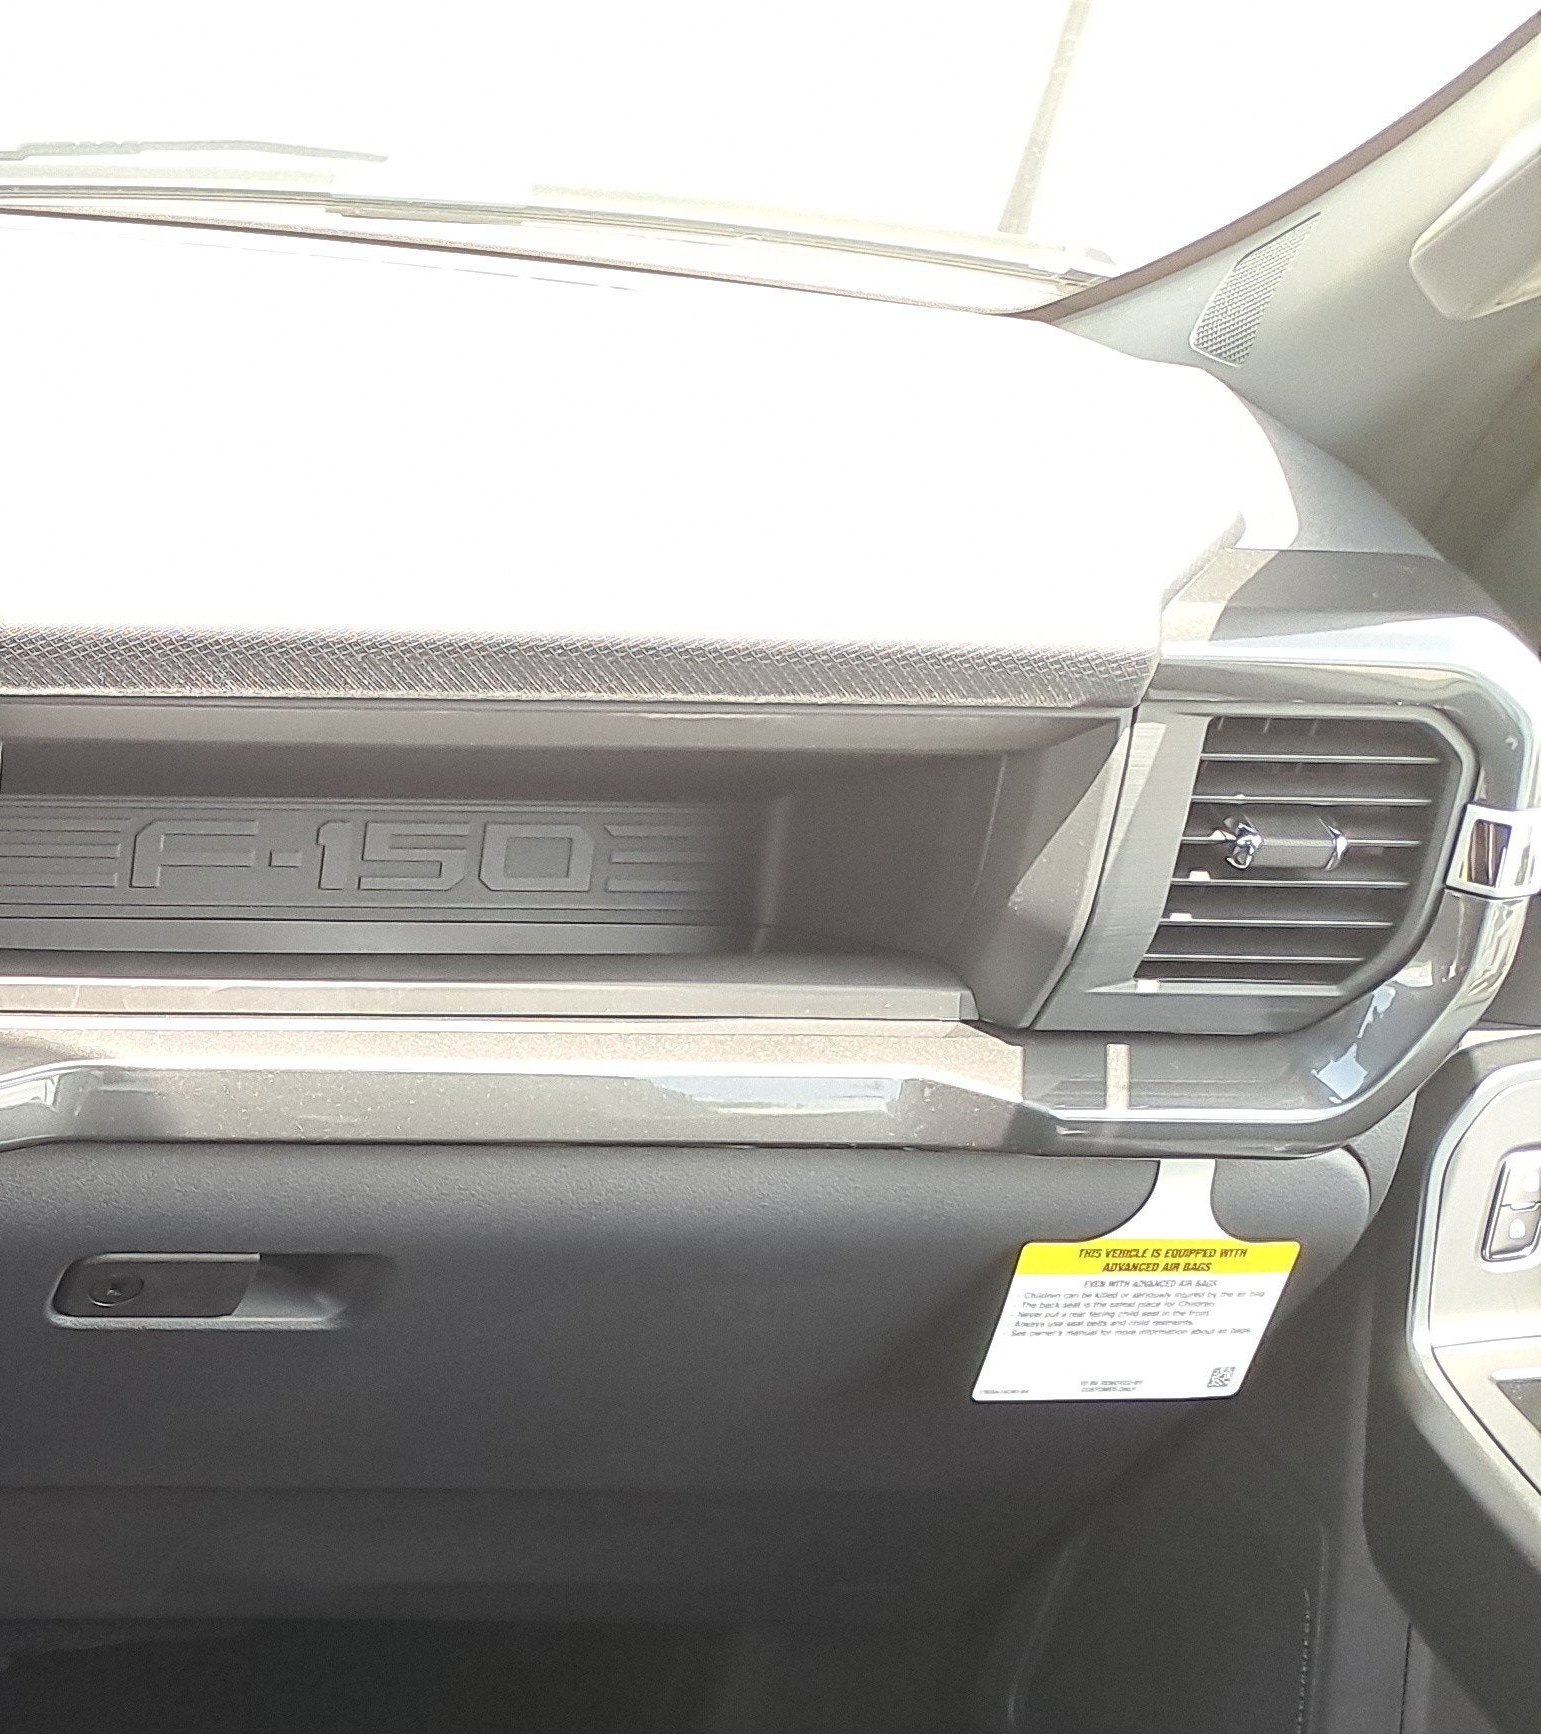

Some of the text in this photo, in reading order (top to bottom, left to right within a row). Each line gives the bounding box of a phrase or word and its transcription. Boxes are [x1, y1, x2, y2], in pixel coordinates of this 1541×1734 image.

[128, 818, 596, 893] F-150
[1078, 1248, 1248, 1259] THIS VEHICLE IS EQUIPPED WITH
[1102, 1262, 1213, 1273] ADVANCED AIR BAGS
